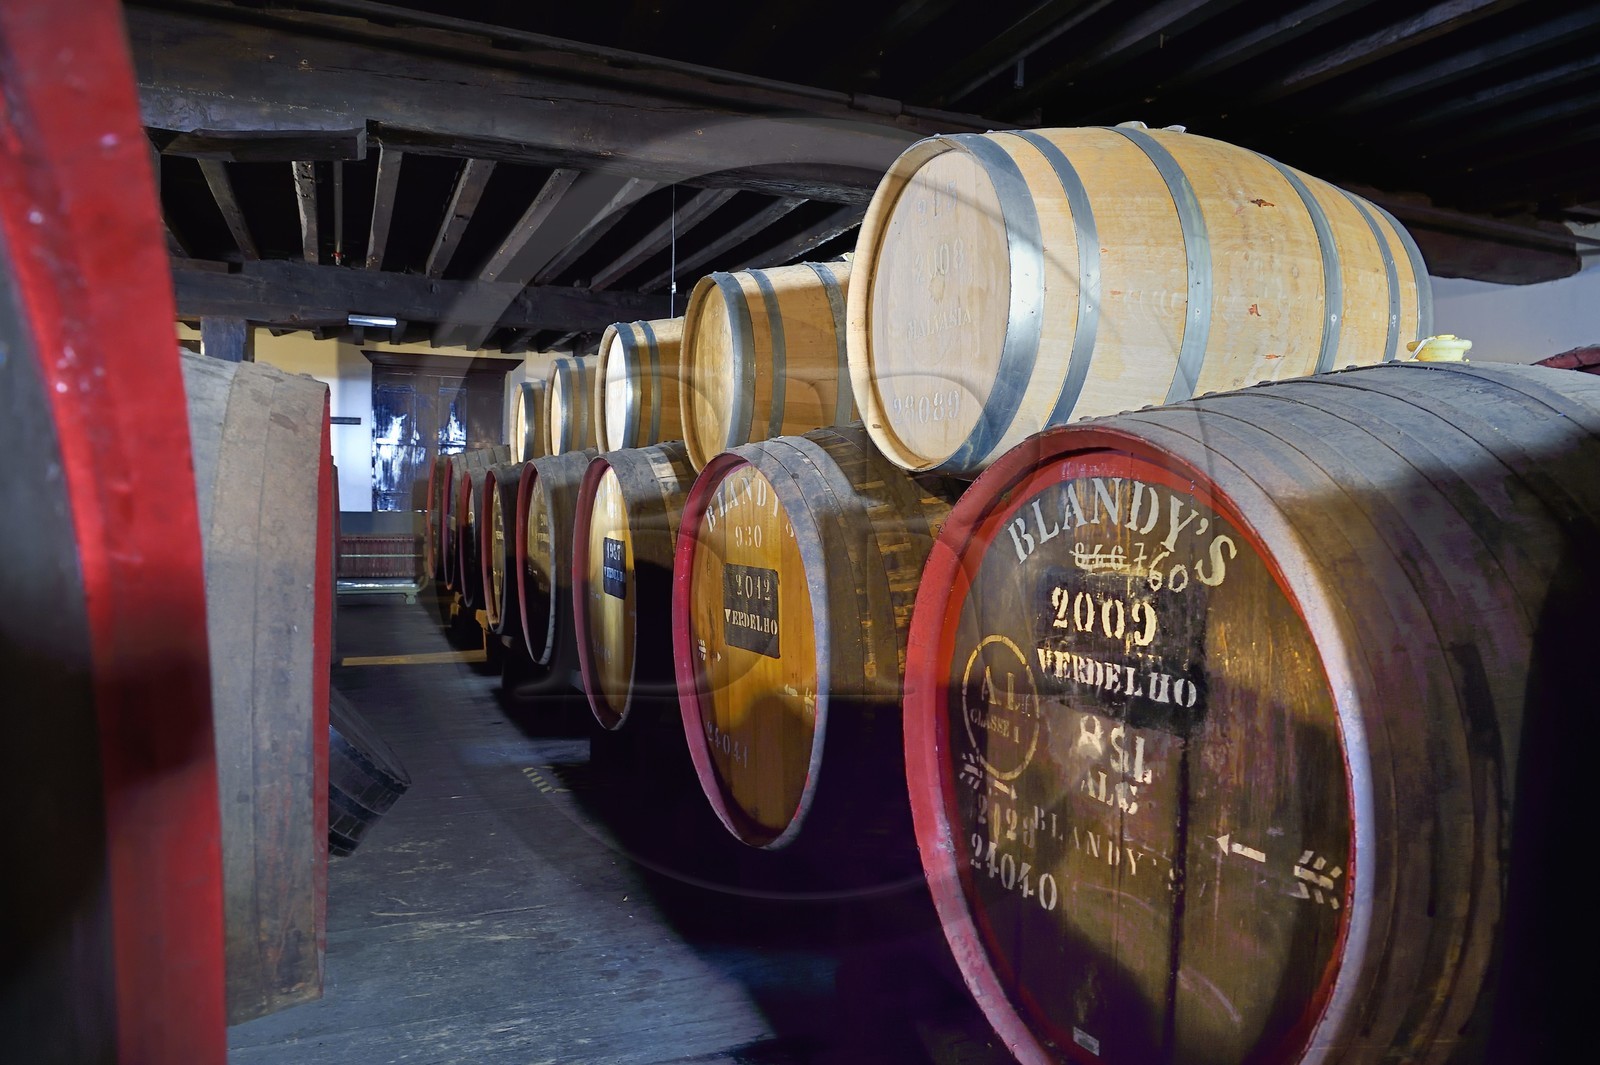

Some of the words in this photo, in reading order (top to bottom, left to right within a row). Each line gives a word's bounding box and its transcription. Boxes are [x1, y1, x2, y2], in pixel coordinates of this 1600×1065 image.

[735, 525, 762, 548] 930
[1007, 477, 1238, 587] BLANDY'S
[735, 574, 771, 600] 2012
[724, 608, 778, 635] VERDELHO
[1052, 586, 1157, 646] 2009
[1037, 648, 1197, 708] VERDELHO
[707, 720, 748, 768] 24041
[970, 832, 1057, 911] 24040
